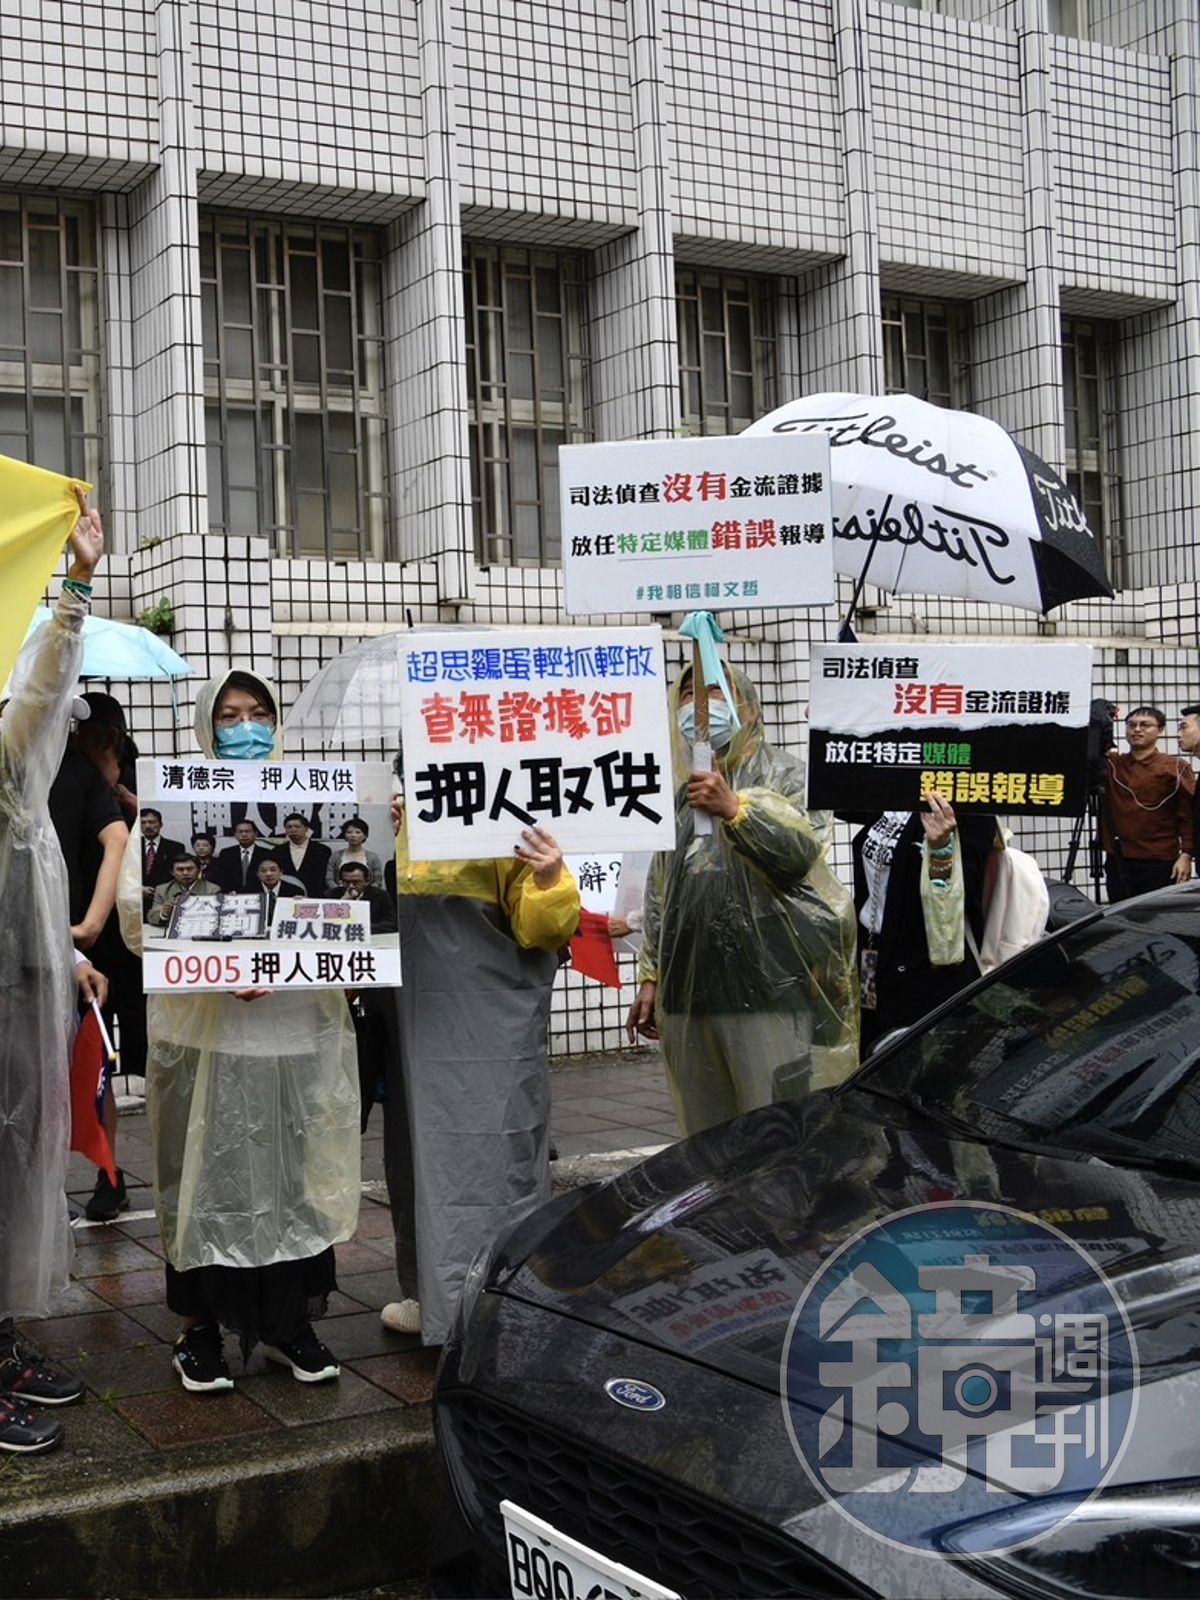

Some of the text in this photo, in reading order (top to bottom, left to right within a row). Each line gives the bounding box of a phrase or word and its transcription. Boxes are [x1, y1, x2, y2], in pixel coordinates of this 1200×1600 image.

[772, 413, 988, 488] Ttleist
[569, 471, 823, 506] 司法偵查沒有金流證據
[571, 519, 826, 557] 放任特定媒體錯誤報導
[636, 580, 759, 600] #我相信柯文哲
[822, 657, 919, 679] 司法偵查
[420, 688, 633, 744] 查無證據卻
[893, 683, 1071, 715] 沒有金流證據
[825, 741, 972, 765] 放任特定媒體
[162, 764, 354, 792] 清德宗 押人取供
[415, 750, 663, 827] 押人取供
[920, 771, 1065, 805] 錯誤報導
[277, 920, 366, 942] 押人取供
[164, 951, 377, 985] 0905 押人取供
[508, 1531, 624, 1600] BQQ-
